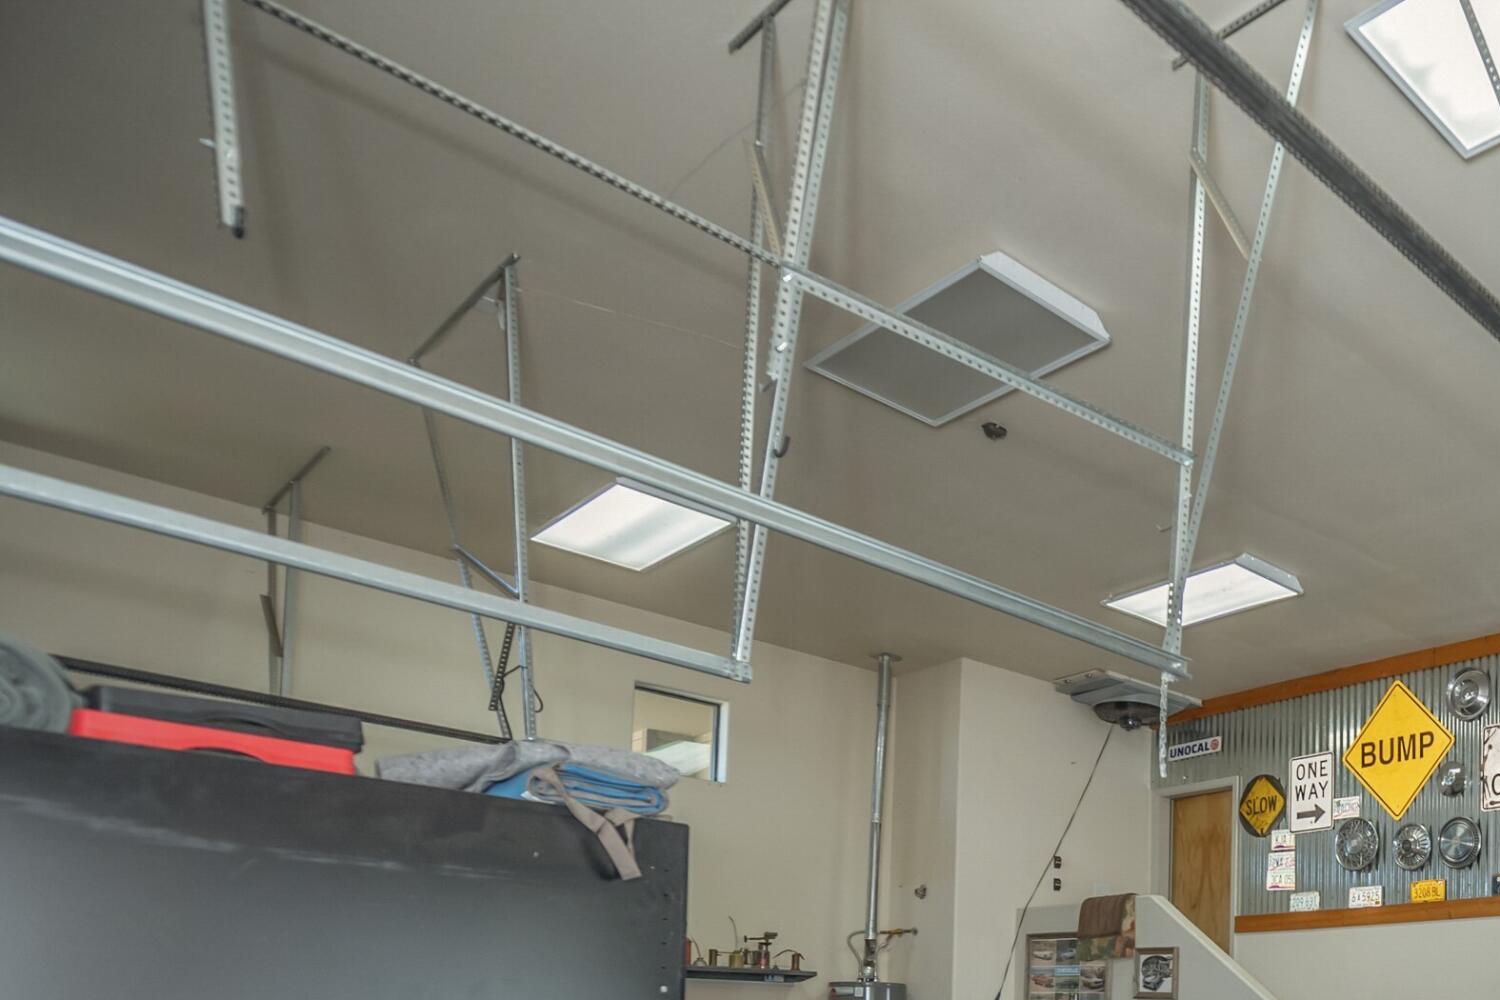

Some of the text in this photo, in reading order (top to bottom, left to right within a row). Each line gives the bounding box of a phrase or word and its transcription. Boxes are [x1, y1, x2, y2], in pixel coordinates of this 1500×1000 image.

[1169, 741, 1210, 758] UNOCAL
[1361, 731, 1435, 768] BUMP
[1296, 759, 1328, 781] ONE
[1295, 780, 1329, 802] WAY
[1245, 795, 1278, 816] SLOW
